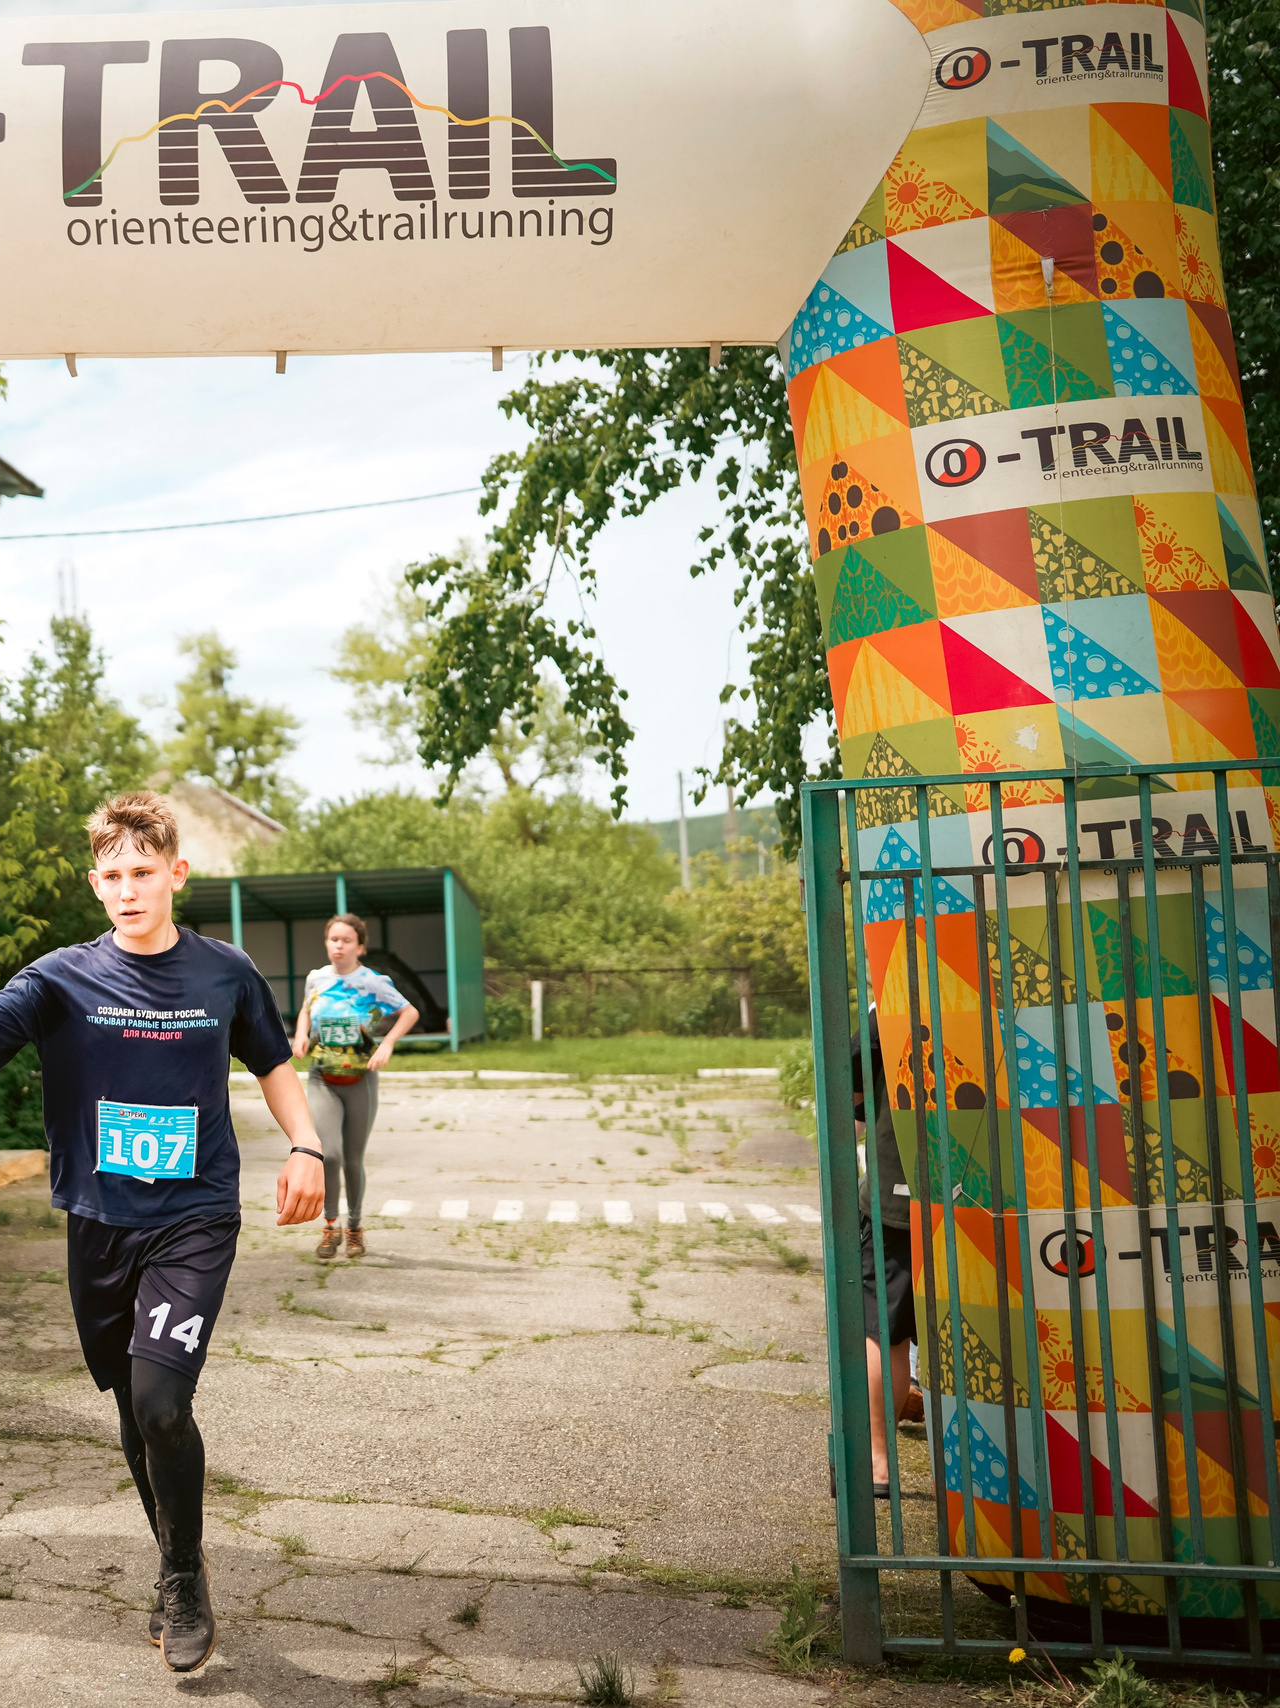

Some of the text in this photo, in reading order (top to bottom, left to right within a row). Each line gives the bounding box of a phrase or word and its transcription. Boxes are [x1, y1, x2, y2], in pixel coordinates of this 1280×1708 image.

[1036, 69, 1164, 86] orienteering&trailrunning
[66, 199, 615, 253] orienteering&trailrunning
[97, 1006, 135, 1017] СОЗДАЕМ
[136, 1010, 173, 1020] БУДУЩЕЕ
[86, 1015, 219, 1030] ОТКРЫВАЯ РАВНЫЕ ВОЗМОЖНОСТИ
[123, 1029, 183, 1041] ДЛЯ КАЖДОГО!
[322, 1025, 359, 1043] 733
[106, 1128, 188, 1170] 107
[148, 1301, 205, 1354] 14
